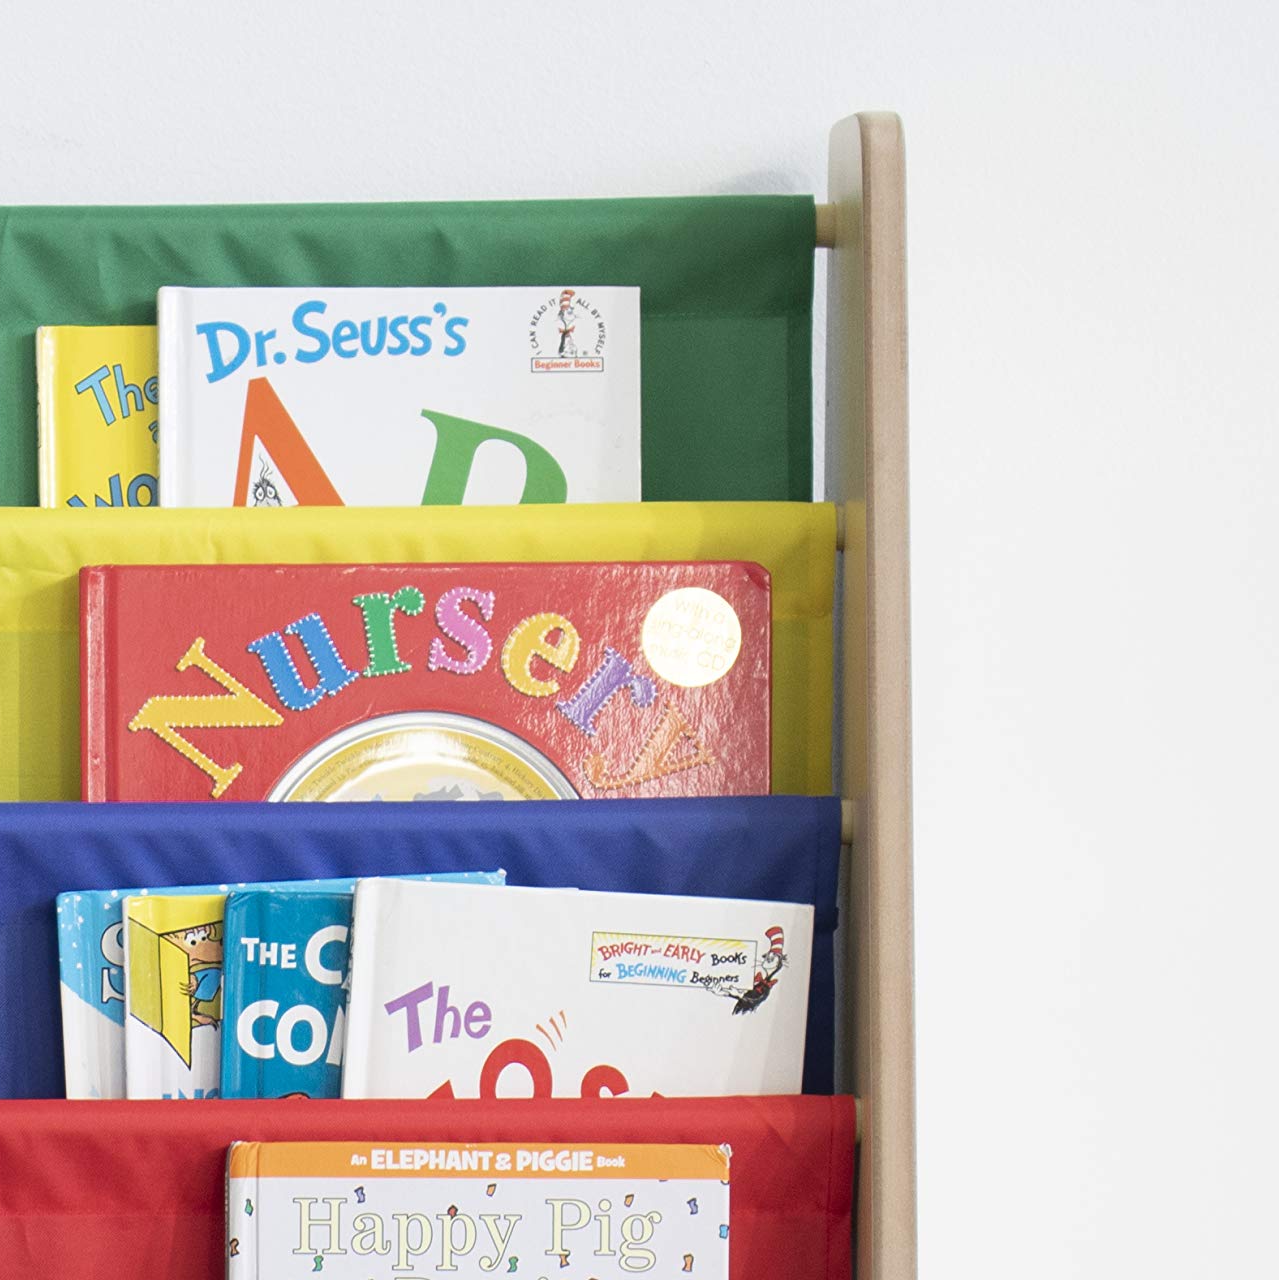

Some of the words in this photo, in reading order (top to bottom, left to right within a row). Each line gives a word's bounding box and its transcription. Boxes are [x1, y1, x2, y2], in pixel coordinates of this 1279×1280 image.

[548, 298, 557, 308] IT
[575, 298, 591, 310] ALL
[590, 308, 601, 320] BY
[530, 304, 548, 327] READ
[195, 319, 287, 385] Dr.
[292, 299, 471, 365] Seuss's
[528, 331, 540, 349] CAN
[594, 321, 607, 355] MYSELF
[534, 360, 572, 371] Beginner
[574, 359, 601, 369] Books
[128, 585, 717, 799] Nursery
[240, 936, 298, 969] THE
[597, 941, 652, 962] BRIGHT
[663, 943, 707, 965] EARLY
[598, 968, 612, 980] for
[616, 962, 688, 984] BEGINNING
[689, 970, 740, 987] Beginners
[383, 980, 493, 1054] The
[350, 1153, 368, 1167] An
[370, 1148, 494, 1171] ELEPHANT
[494, 1152, 512, 1171] &
[515, 1150, 595, 1172] PIGGIE
[596, 1155, 626, 1168] Book
[291, 1196, 523, 1272] Happy
[544, 1197, 664, 1272] Pig
